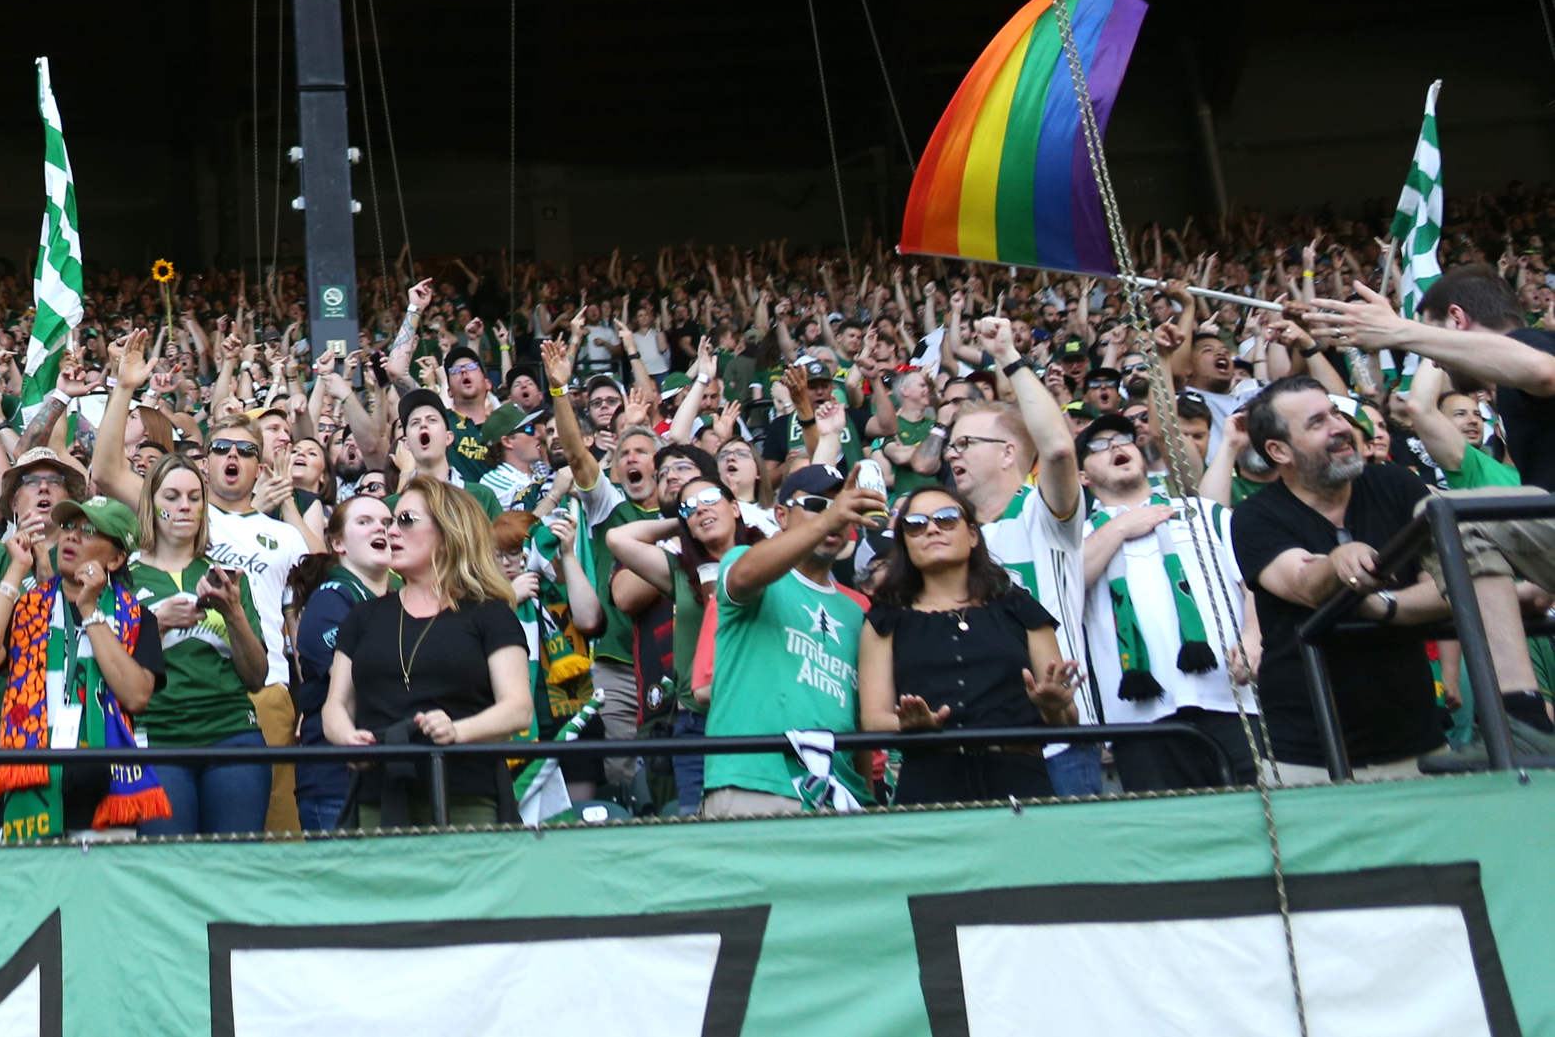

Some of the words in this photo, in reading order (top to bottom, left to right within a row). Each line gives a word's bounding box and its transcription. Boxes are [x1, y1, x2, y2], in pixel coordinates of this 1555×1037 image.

[208, 541, 269, 576] Alaska
[784, 625, 859, 691] Timbers
[796, 656, 847, 709] Army
